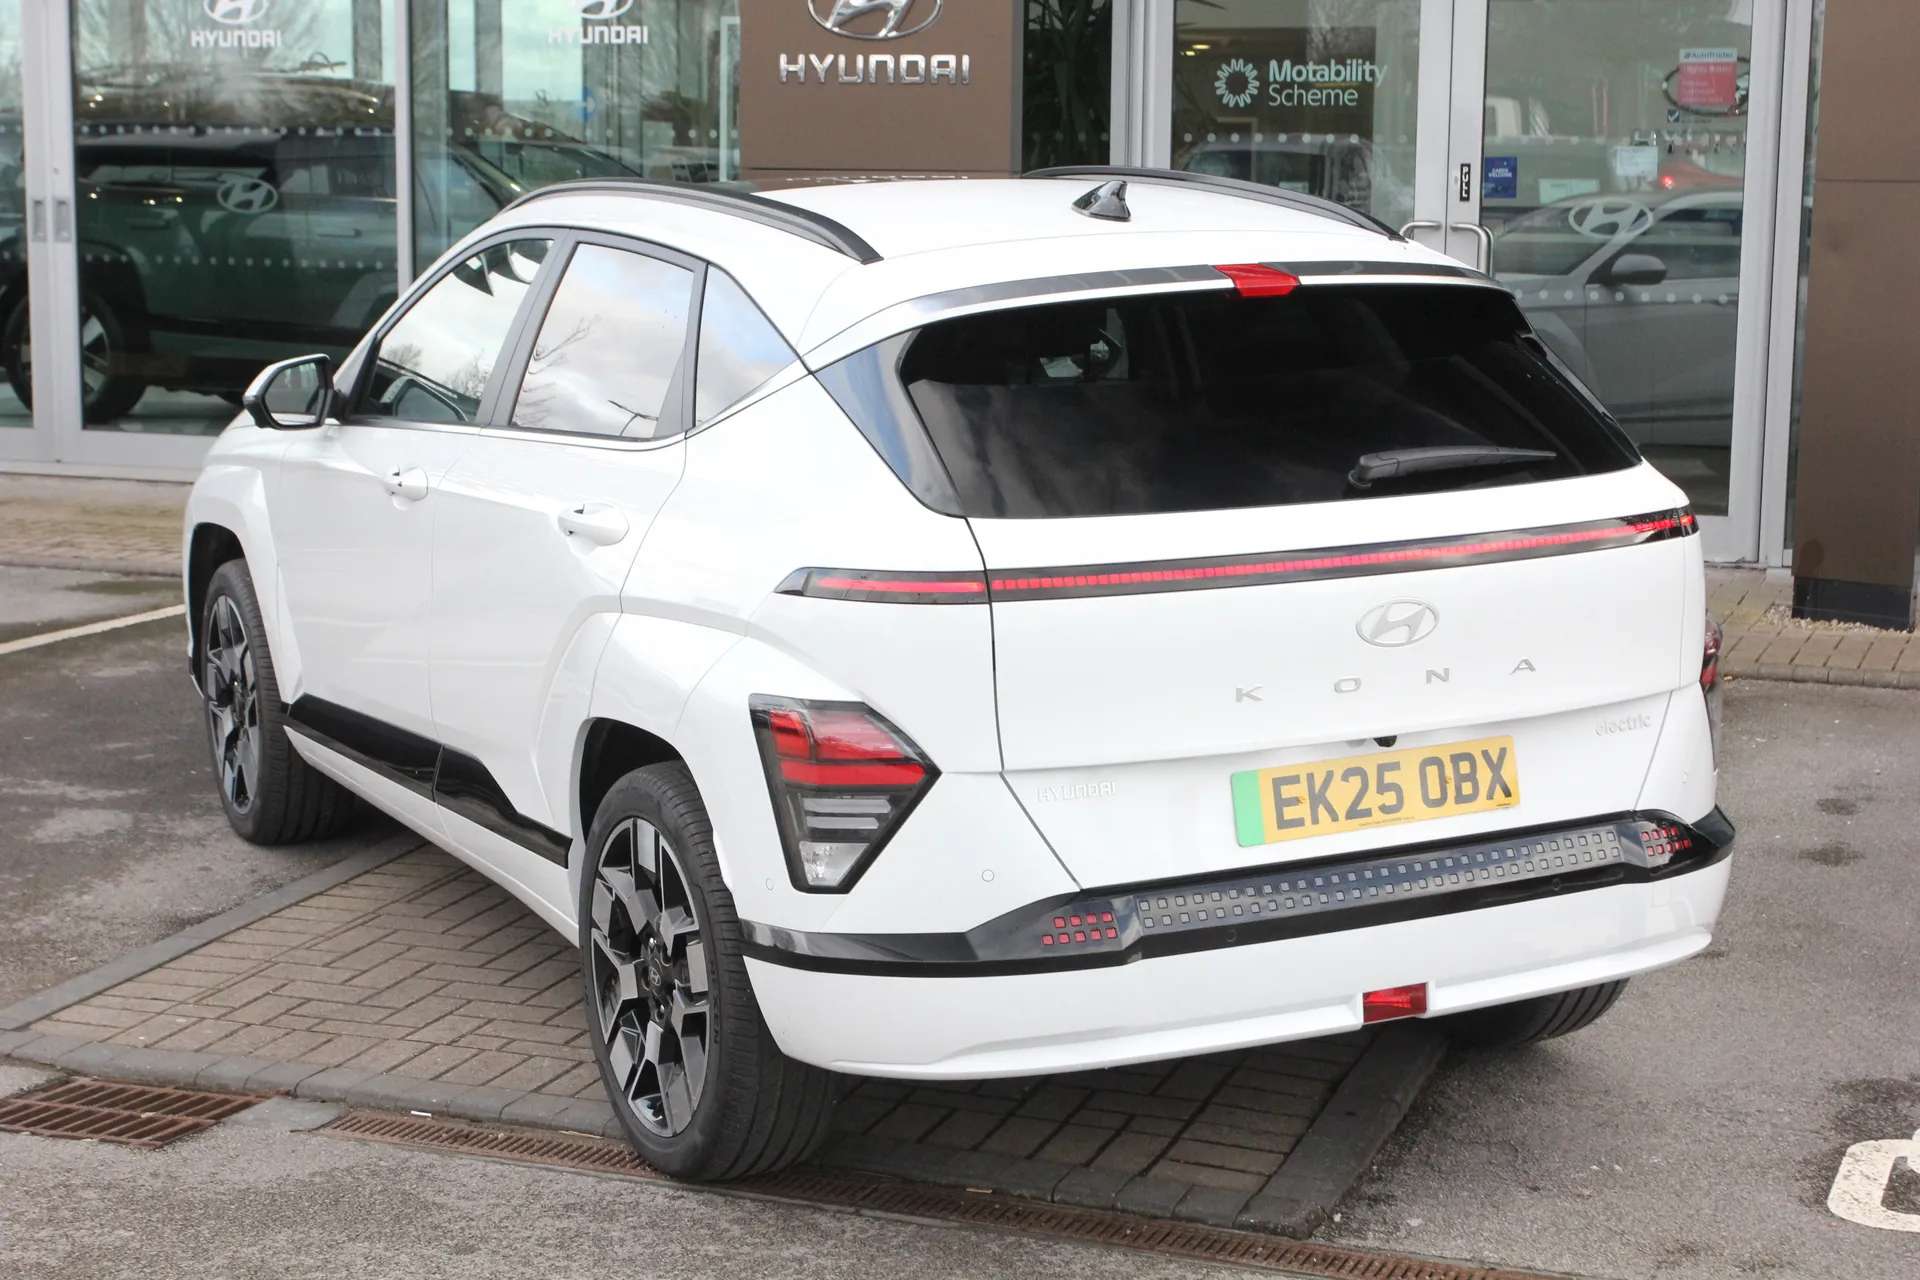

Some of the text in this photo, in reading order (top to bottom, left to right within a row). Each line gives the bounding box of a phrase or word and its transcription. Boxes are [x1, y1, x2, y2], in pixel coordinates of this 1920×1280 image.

[190, 30, 282, 48] HYUNDAI
[548, 25, 648, 44] HYUNDAI
[779, 53, 970, 84] HYUNDAI
[1268, 58, 1387, 88] Motability
[1268, 84, 1359, 106] Scheme
[1235, 658, 1536, 703] KONA
[1594, 712, 1651, 736] electric
[1033, 781, 1117, 801] HYUNDAI
[1272, 747, 1512, 830] EK25 OBX
